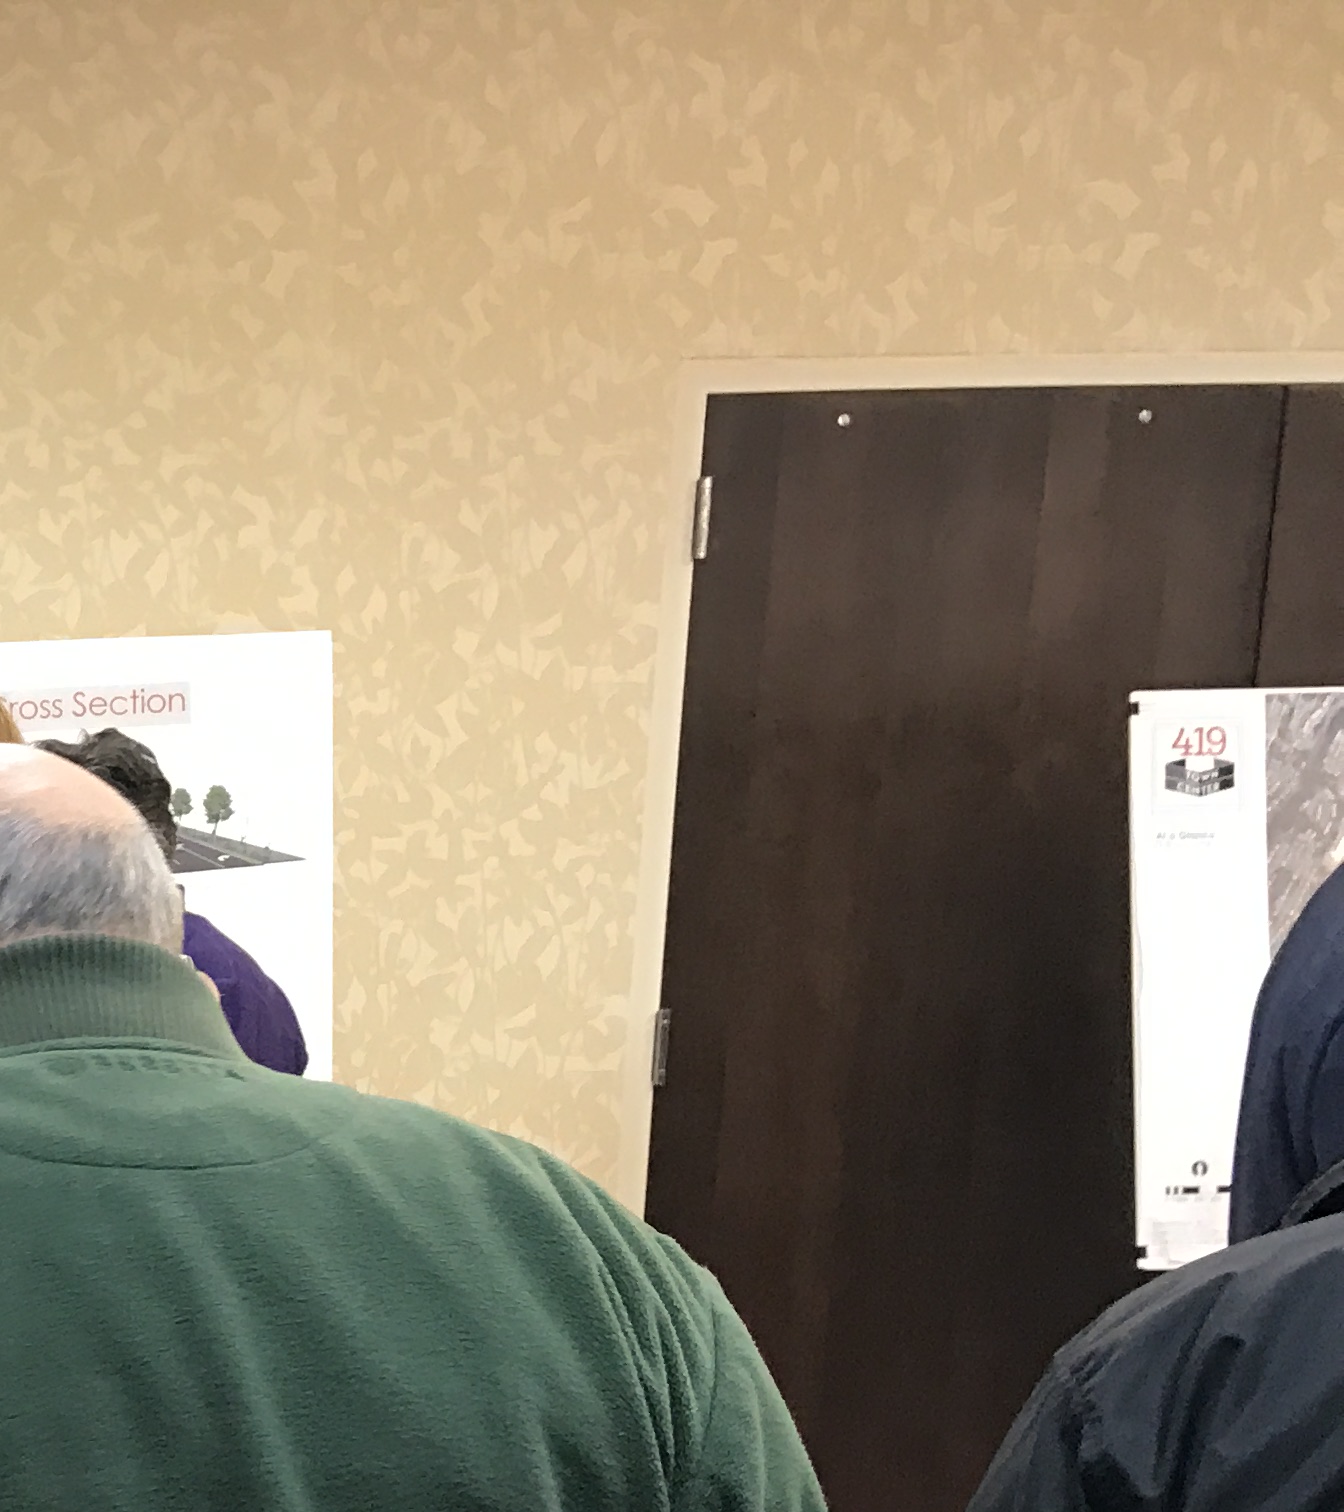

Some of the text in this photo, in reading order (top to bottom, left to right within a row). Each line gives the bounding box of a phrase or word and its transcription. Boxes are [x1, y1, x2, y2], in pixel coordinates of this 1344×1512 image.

[2, 697, 64, 721] ross
[71, 687, 187, 718] Section
[1171, 725, 1228, 757] 419
